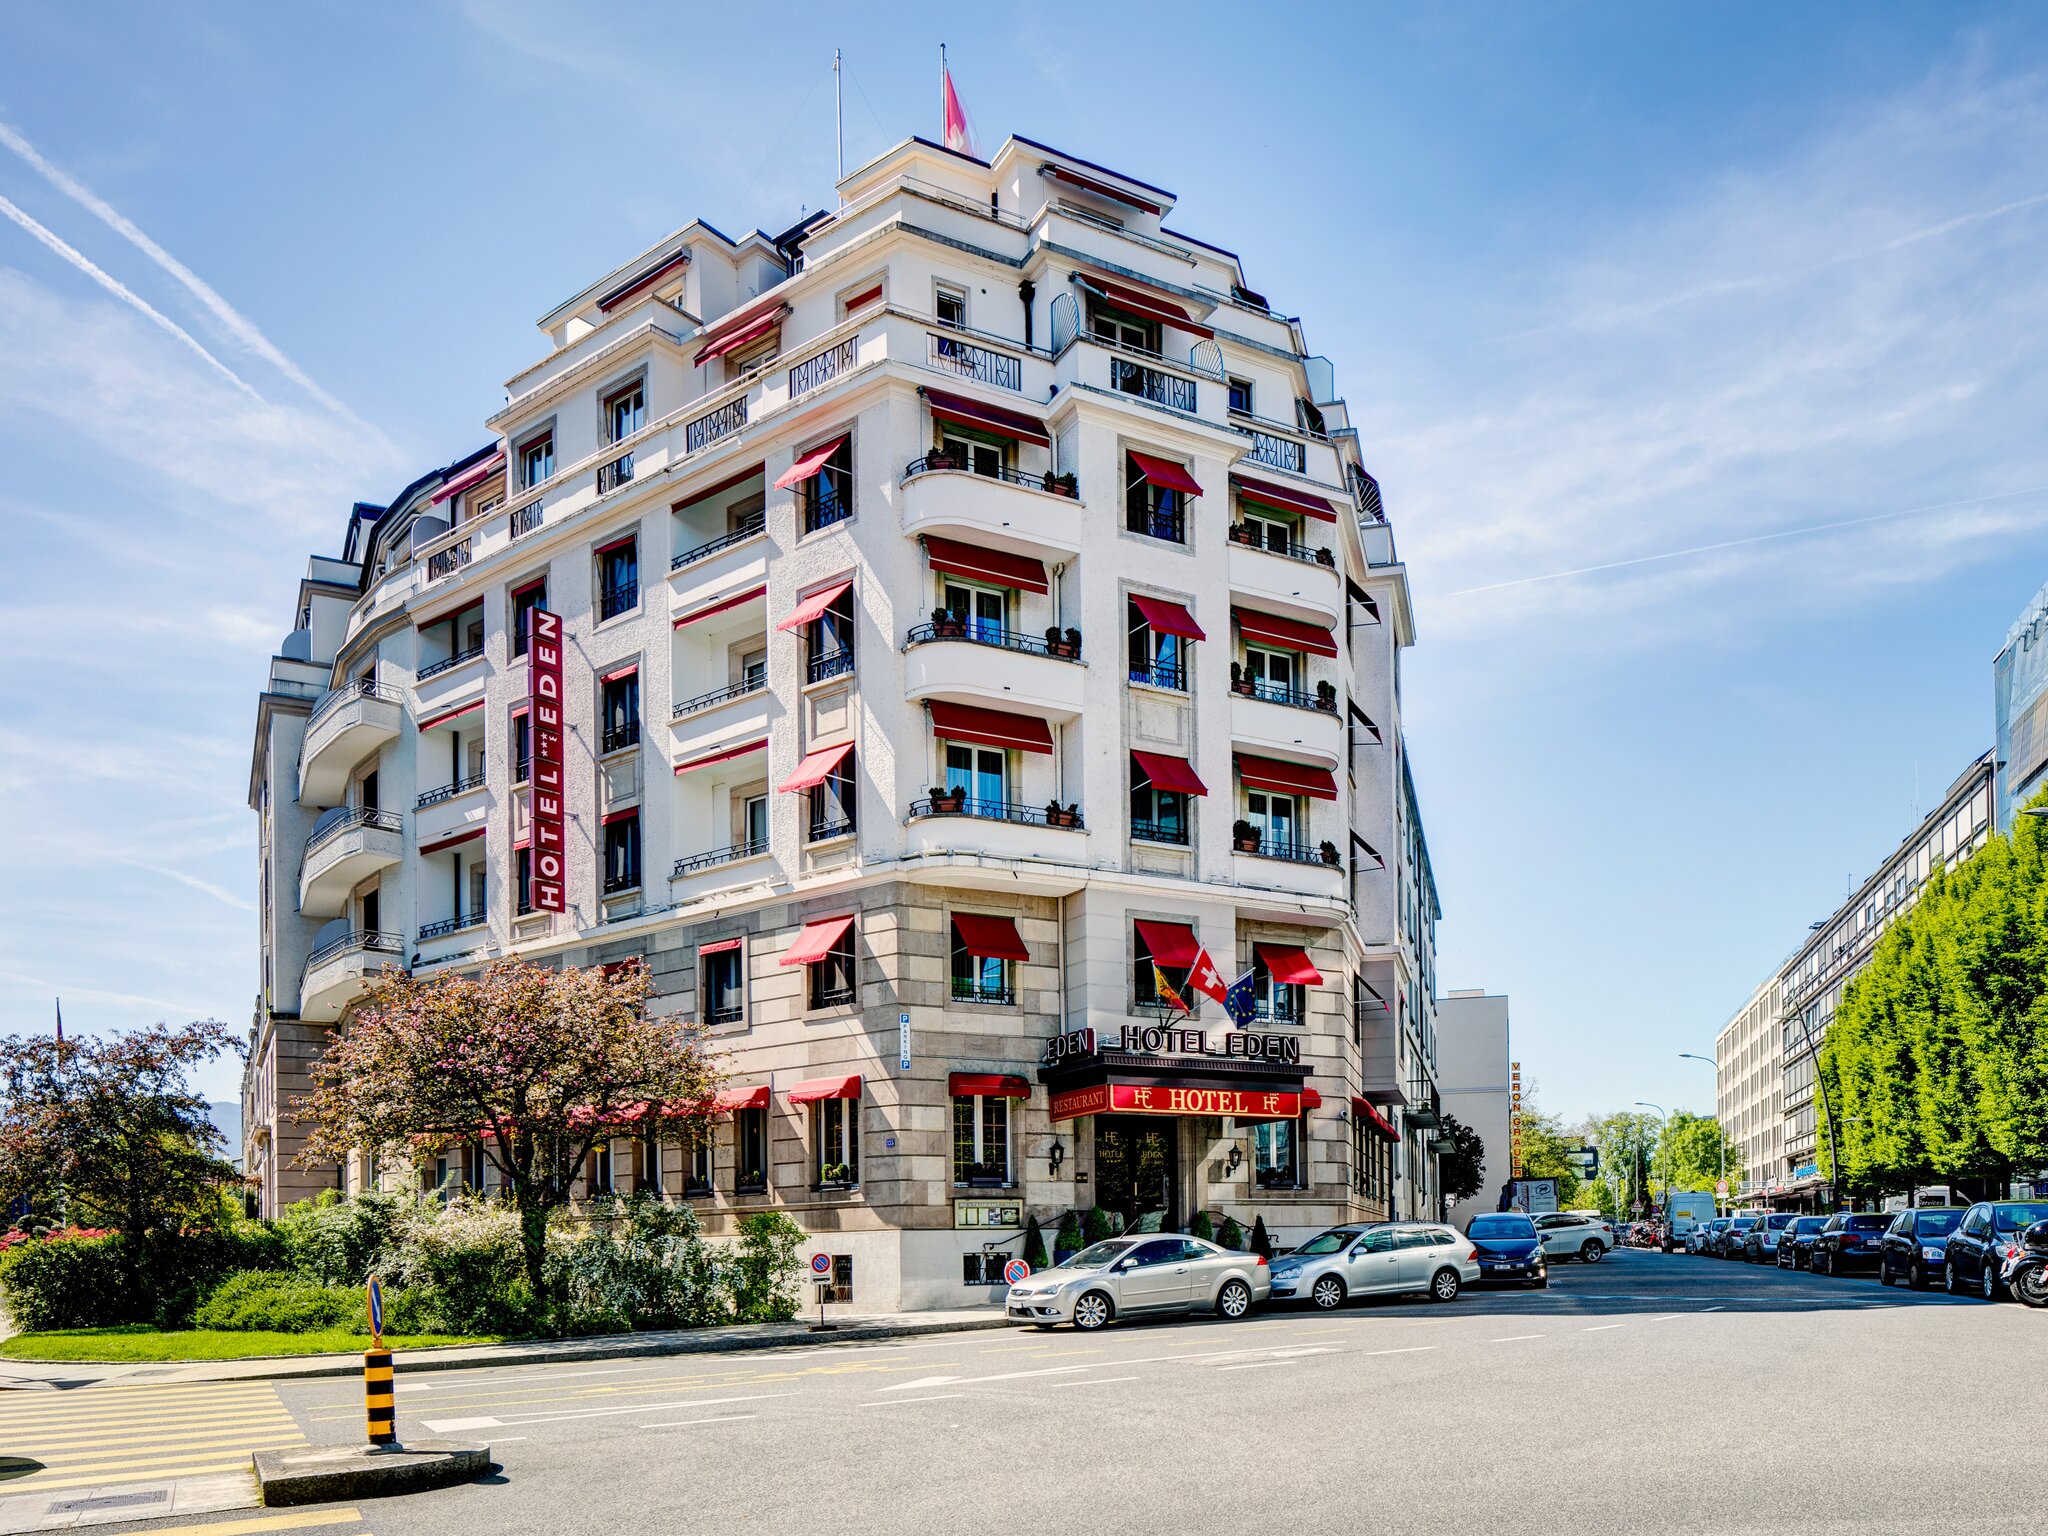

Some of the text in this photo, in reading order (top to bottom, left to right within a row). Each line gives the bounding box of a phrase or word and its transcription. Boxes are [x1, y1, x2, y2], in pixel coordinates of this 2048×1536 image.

[539, 612, 559, 908] HOTEL EDEN
[1047, 1028, 1088, 1059] EDEN
[1121, 1025, 1299, 1060] HOTEL EDEN
[1053, 1091, 1104, 1114] RESTAURANT
[1168, 1088, 1248, 1113] HOTEL
[1512, 1062, 1521, 1178] VERON GRAUER
